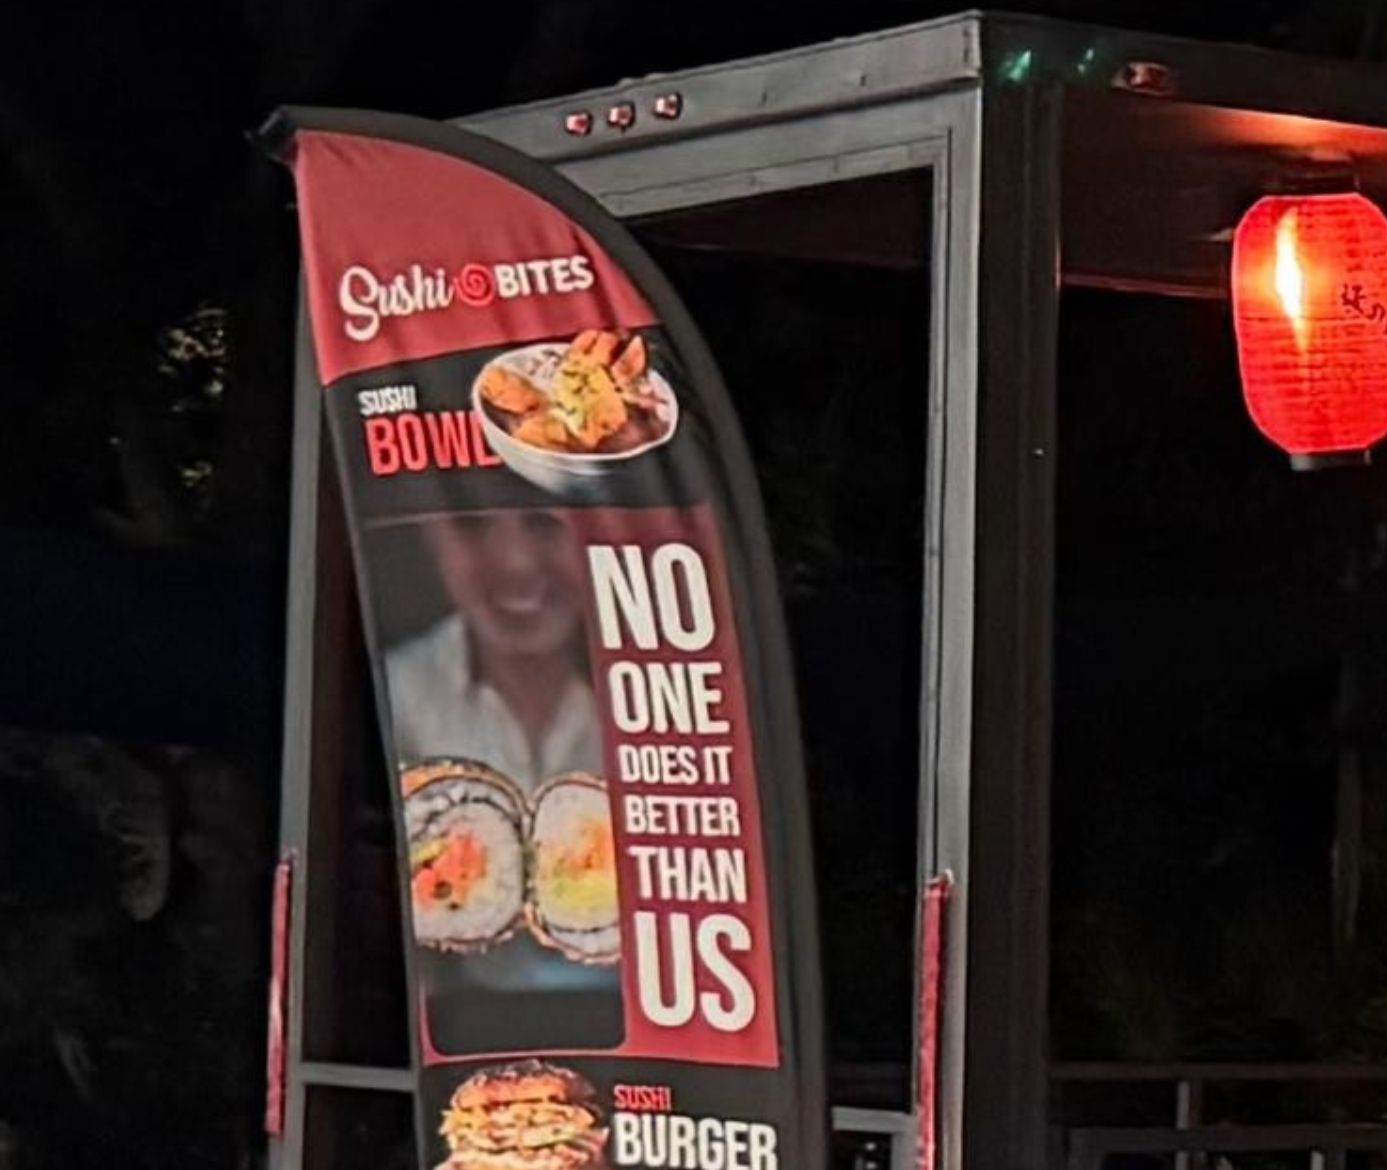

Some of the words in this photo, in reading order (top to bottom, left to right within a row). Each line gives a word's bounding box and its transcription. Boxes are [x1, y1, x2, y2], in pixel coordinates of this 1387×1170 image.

[339, 264, 452, 342] Sushi
[495, 255, 594, 299] BITES
[359, 385, 416, 417] SUSHI
[366, 411, 502, 476] BOWL
[587, 543, 715, 651] NO
[608, 661, 731, 735] ONE
[618, 745, 699, 785] DOES
[703, 745, 733, 785] IT
[624, 795, 741, 838] BETTER
[627, 846, 747, 903] THAN
[634, 911, 757, 1032] US
[613, 1085, 672, 1111] SUSHI
